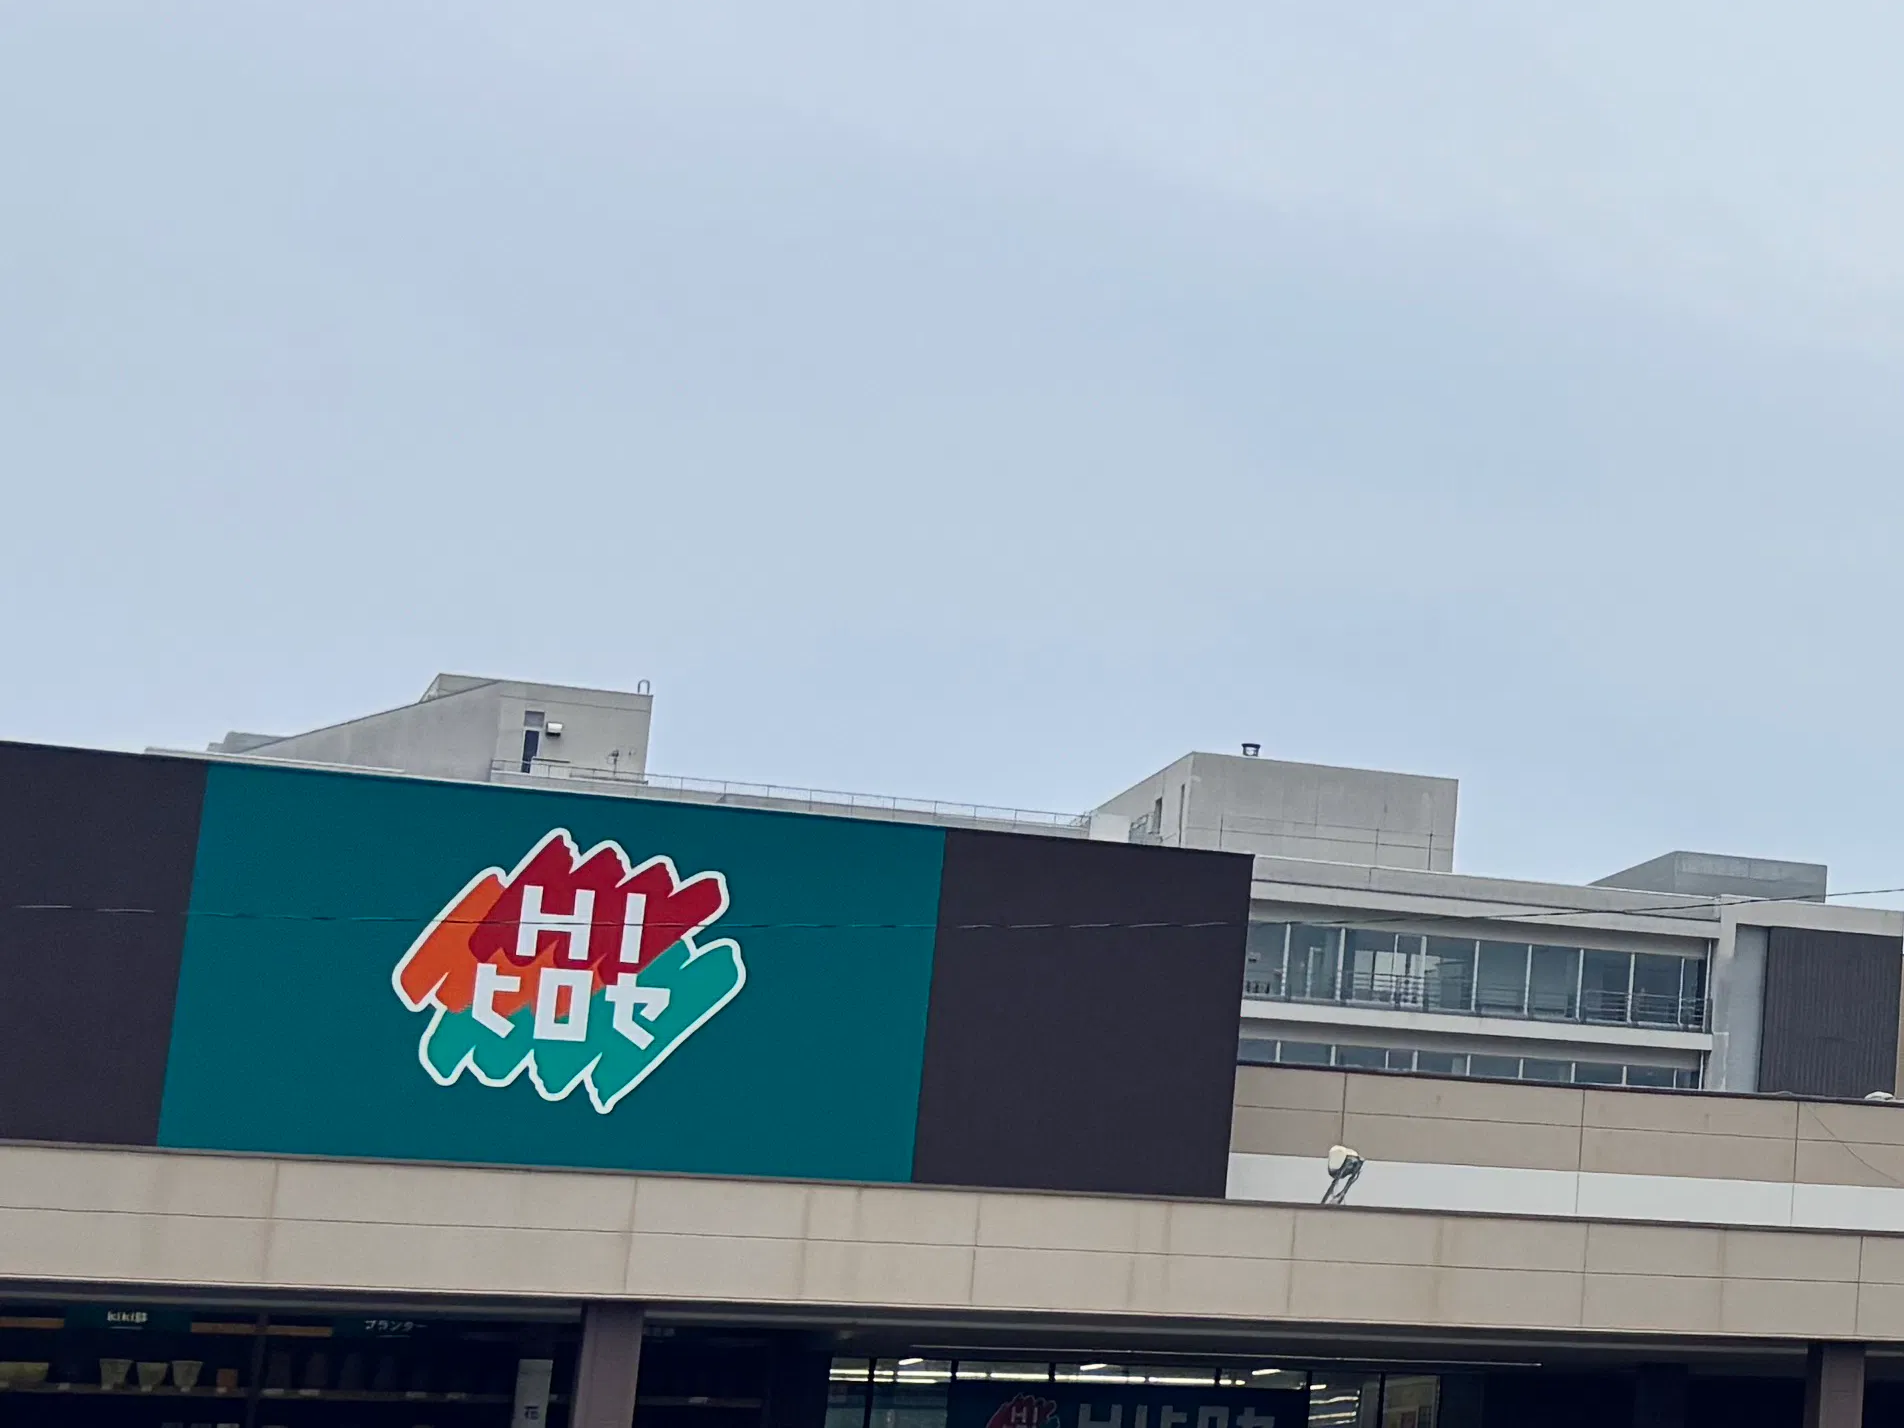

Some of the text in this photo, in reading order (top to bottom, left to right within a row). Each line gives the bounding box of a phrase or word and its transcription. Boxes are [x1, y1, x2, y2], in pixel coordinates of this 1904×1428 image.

[515, 884, 648, 964] HI
[471, 962, 672, 1051] ヒロセ
[1010, 1405, 1039, 1424] HI
